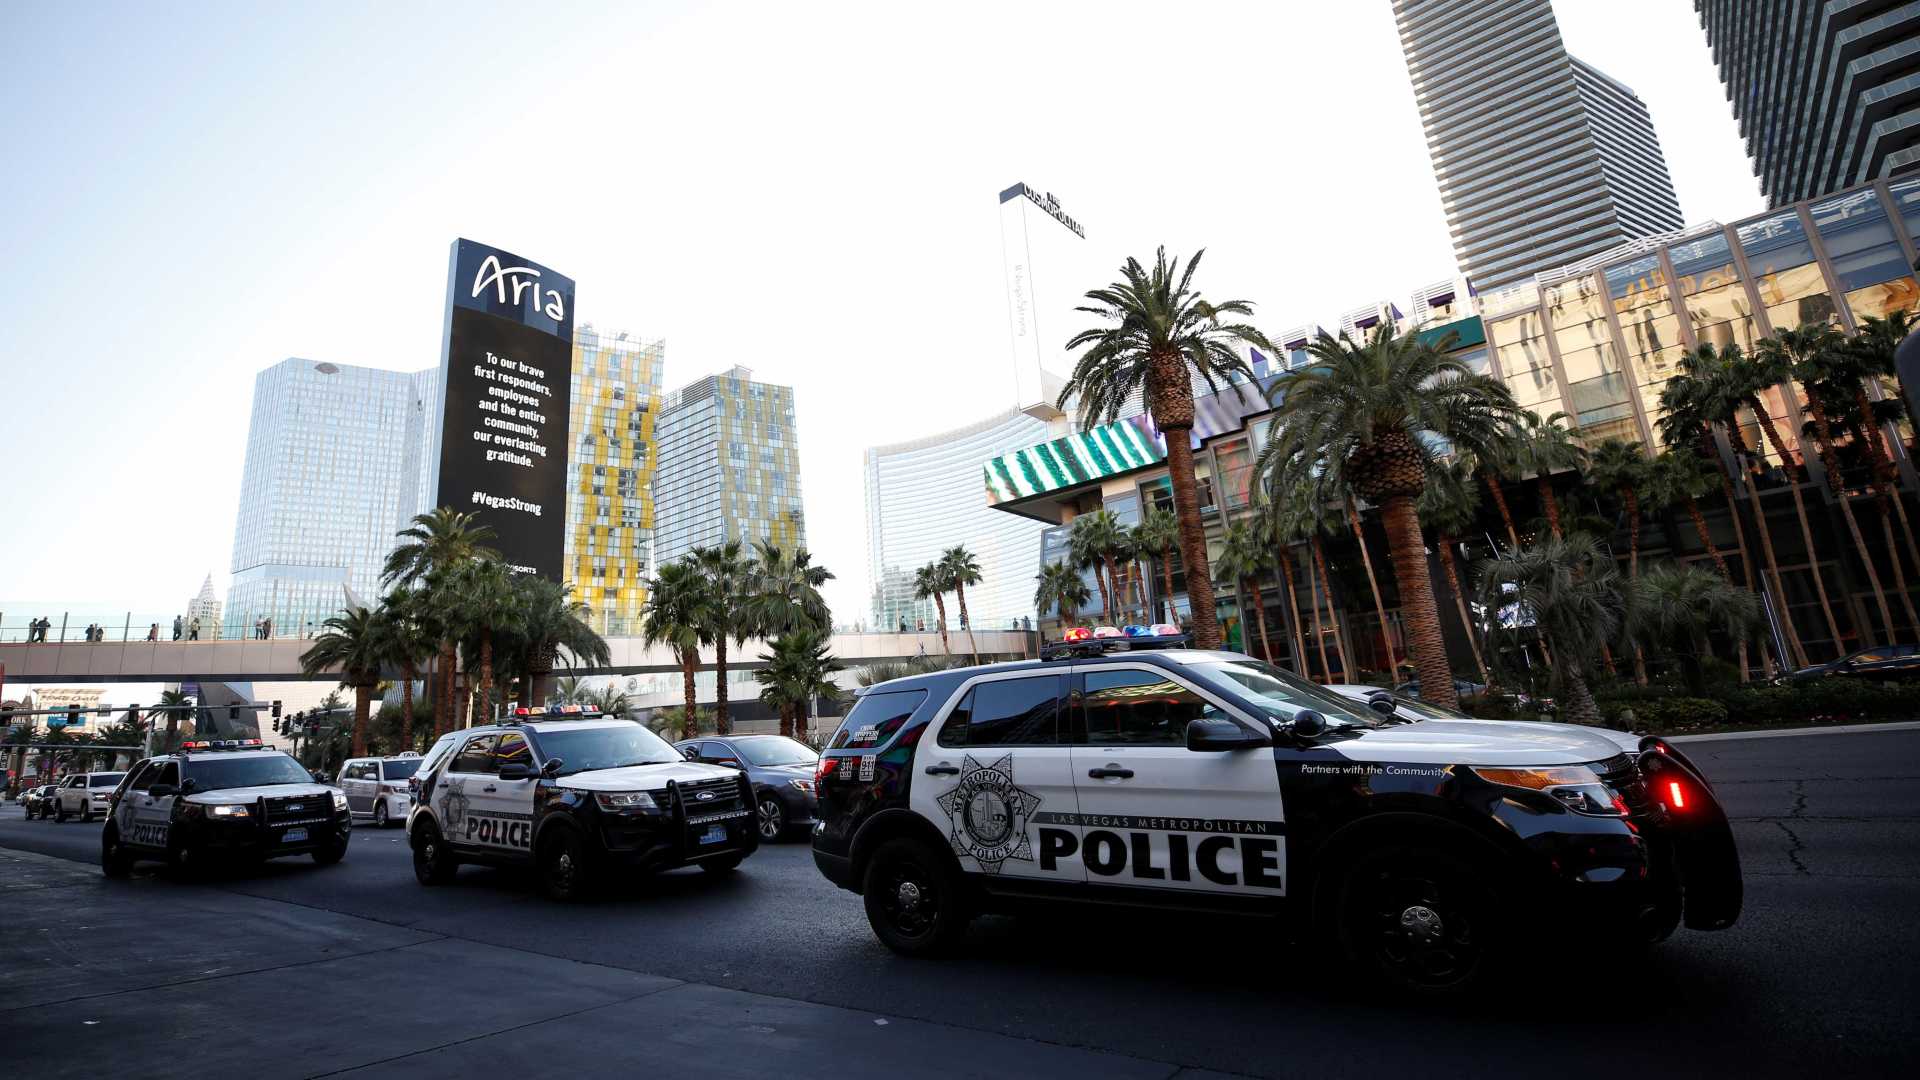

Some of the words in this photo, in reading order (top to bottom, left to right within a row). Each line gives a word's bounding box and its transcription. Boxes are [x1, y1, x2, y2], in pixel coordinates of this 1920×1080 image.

[472, 255, 564, 321] Aria
[486, 352, 497, 364] To
[500, 358, 517, 370] our
[519, 361, 544, 378] brave
[474, 365, 495, 380] first
[498, 373, 552, 397] responders,
[488, 386, 539, 407] employees
[478, 400, 498, 412] and
[500, 403, 517, 416] the
[519, 409, 546, 424] entire
[484, 417, 539, 438] community,
[473, 431, 492, 442] our
[494, 434, 547, 456] everlasting
[486, 449, 534, 467] gratitude.
[472, 491, 542, 516] #VegasStrong
[861, 761, 875, 770] 911
[1301, 764, 1340, 775] Partners
[1342, 765, 1364, 775] with
[1367, 765, 1383, 775] the
[1386, 765, 1447, 778] Community
[954, 770, 1022, 816] METROPOLITAN
[720, 811, 749, 820] POLICE
[1051, 814, 1075, 824] LAS
[1082, 815, 1129, 827] VEGAS
[1137, 818, 1266, 833] METROPOLITAN
[132, 824, 168, 845] POLICE
[465, 816, 531, 848] POLICE
[969, 843, 1012, 860] POLICE
[1038, 827, 1282, 889] POLICE
